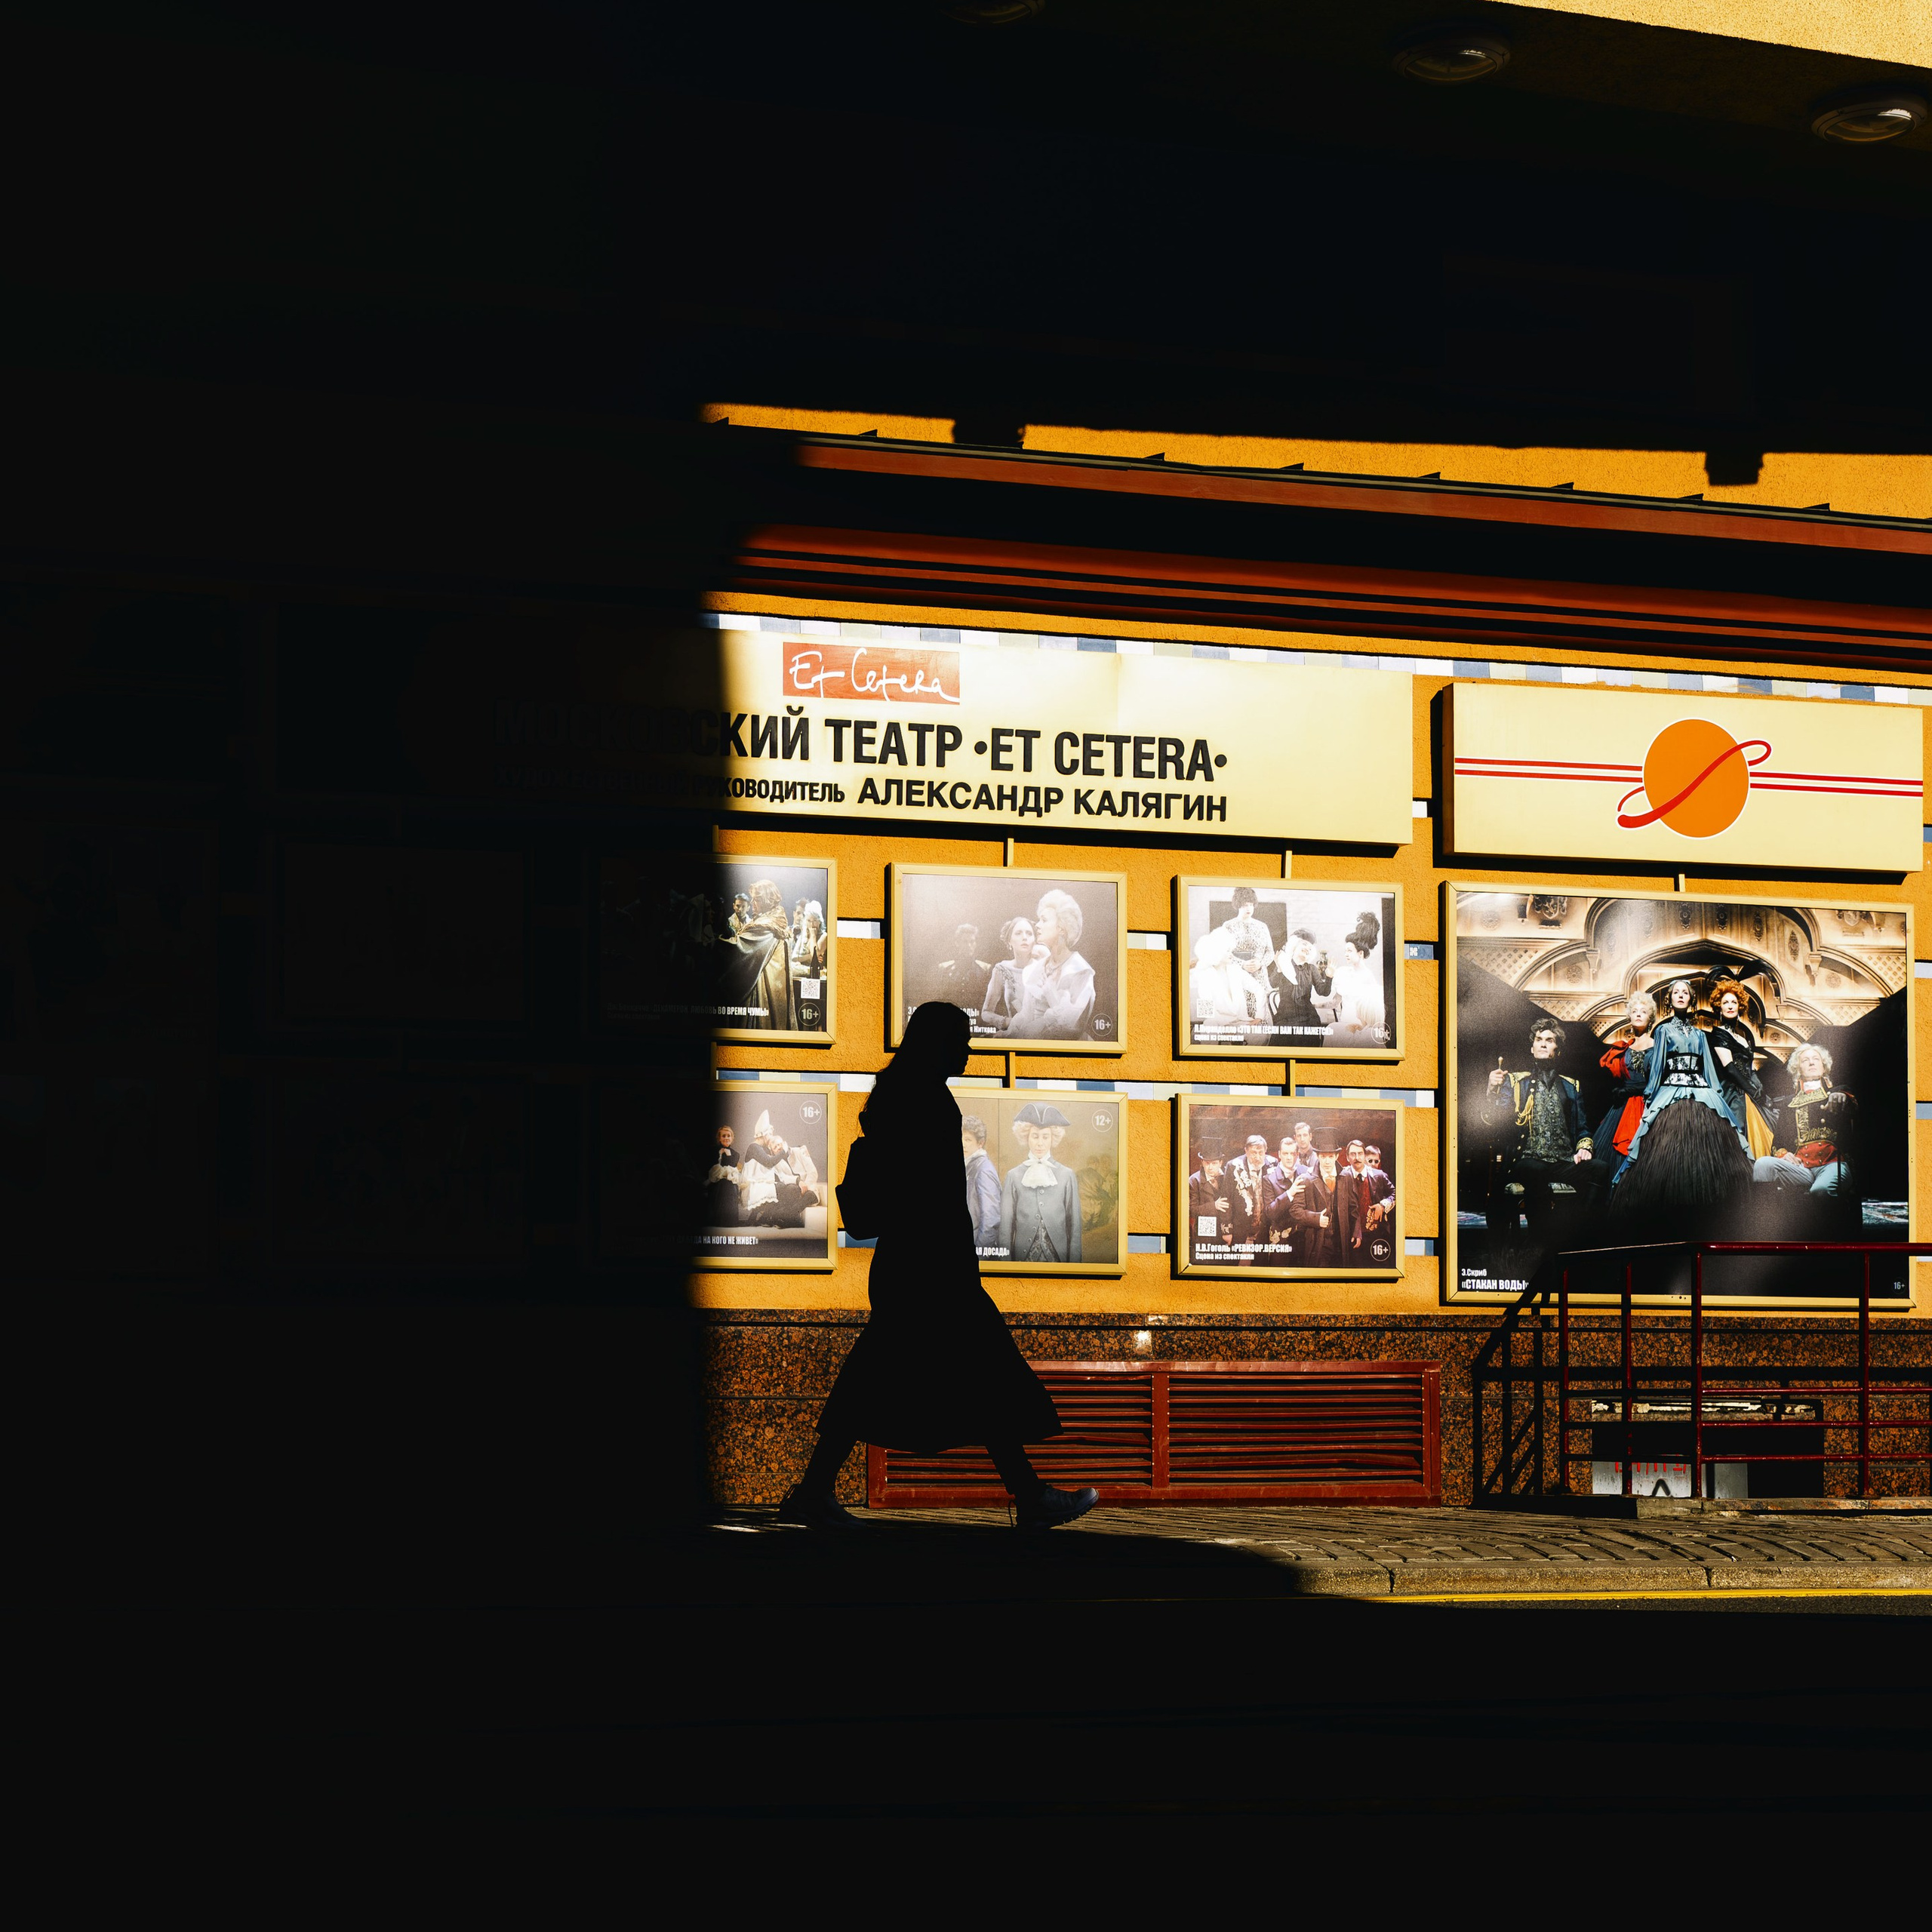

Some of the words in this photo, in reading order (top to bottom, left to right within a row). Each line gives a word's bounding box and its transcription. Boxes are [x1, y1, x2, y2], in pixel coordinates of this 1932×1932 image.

[789, 651, 845, 698] Et
[825, 718, 962, 768] ТЕАТР
[694, 775, 845, 803] РУКОВОДИТЕЛЬ
[857, 777, 1063, 817] АЛЕКСАНДР
[1074, 789, 1226, 822] КАЛЯГИН
[718, 1007, 726, 1015] ВО
[727, 1007, 746, 1016] ВРЕМЯ
[801, 1008, 819, 1020] 16+
[1094, 1019, 1111, 1030] 16+
[1280, 1026, 1292, 1035] ВАМ
[1293, 1026, 1303, 1035] ТАК
[803, 1106, 820, 1118] 16+
[1095, 1115, 1111, 1126] 12+
[712, 1235, 727, 1244] КОГО
[728, 1235, 735, 1244] НЕ
[1195, 1244, 1230, 1252] Н.В.Гоголь
[1232, 1244, 1292, 1253] «РЕВИЗОР.ВЕРСИЯ»
[1373, 1244, 1389, 1256] 16+
[1195, 1252, 1214, 1260] Сцена
[1462, 1279, 1497, 1290] «СТАКАН
[1894, 1281, 1906, 1290] 16+
